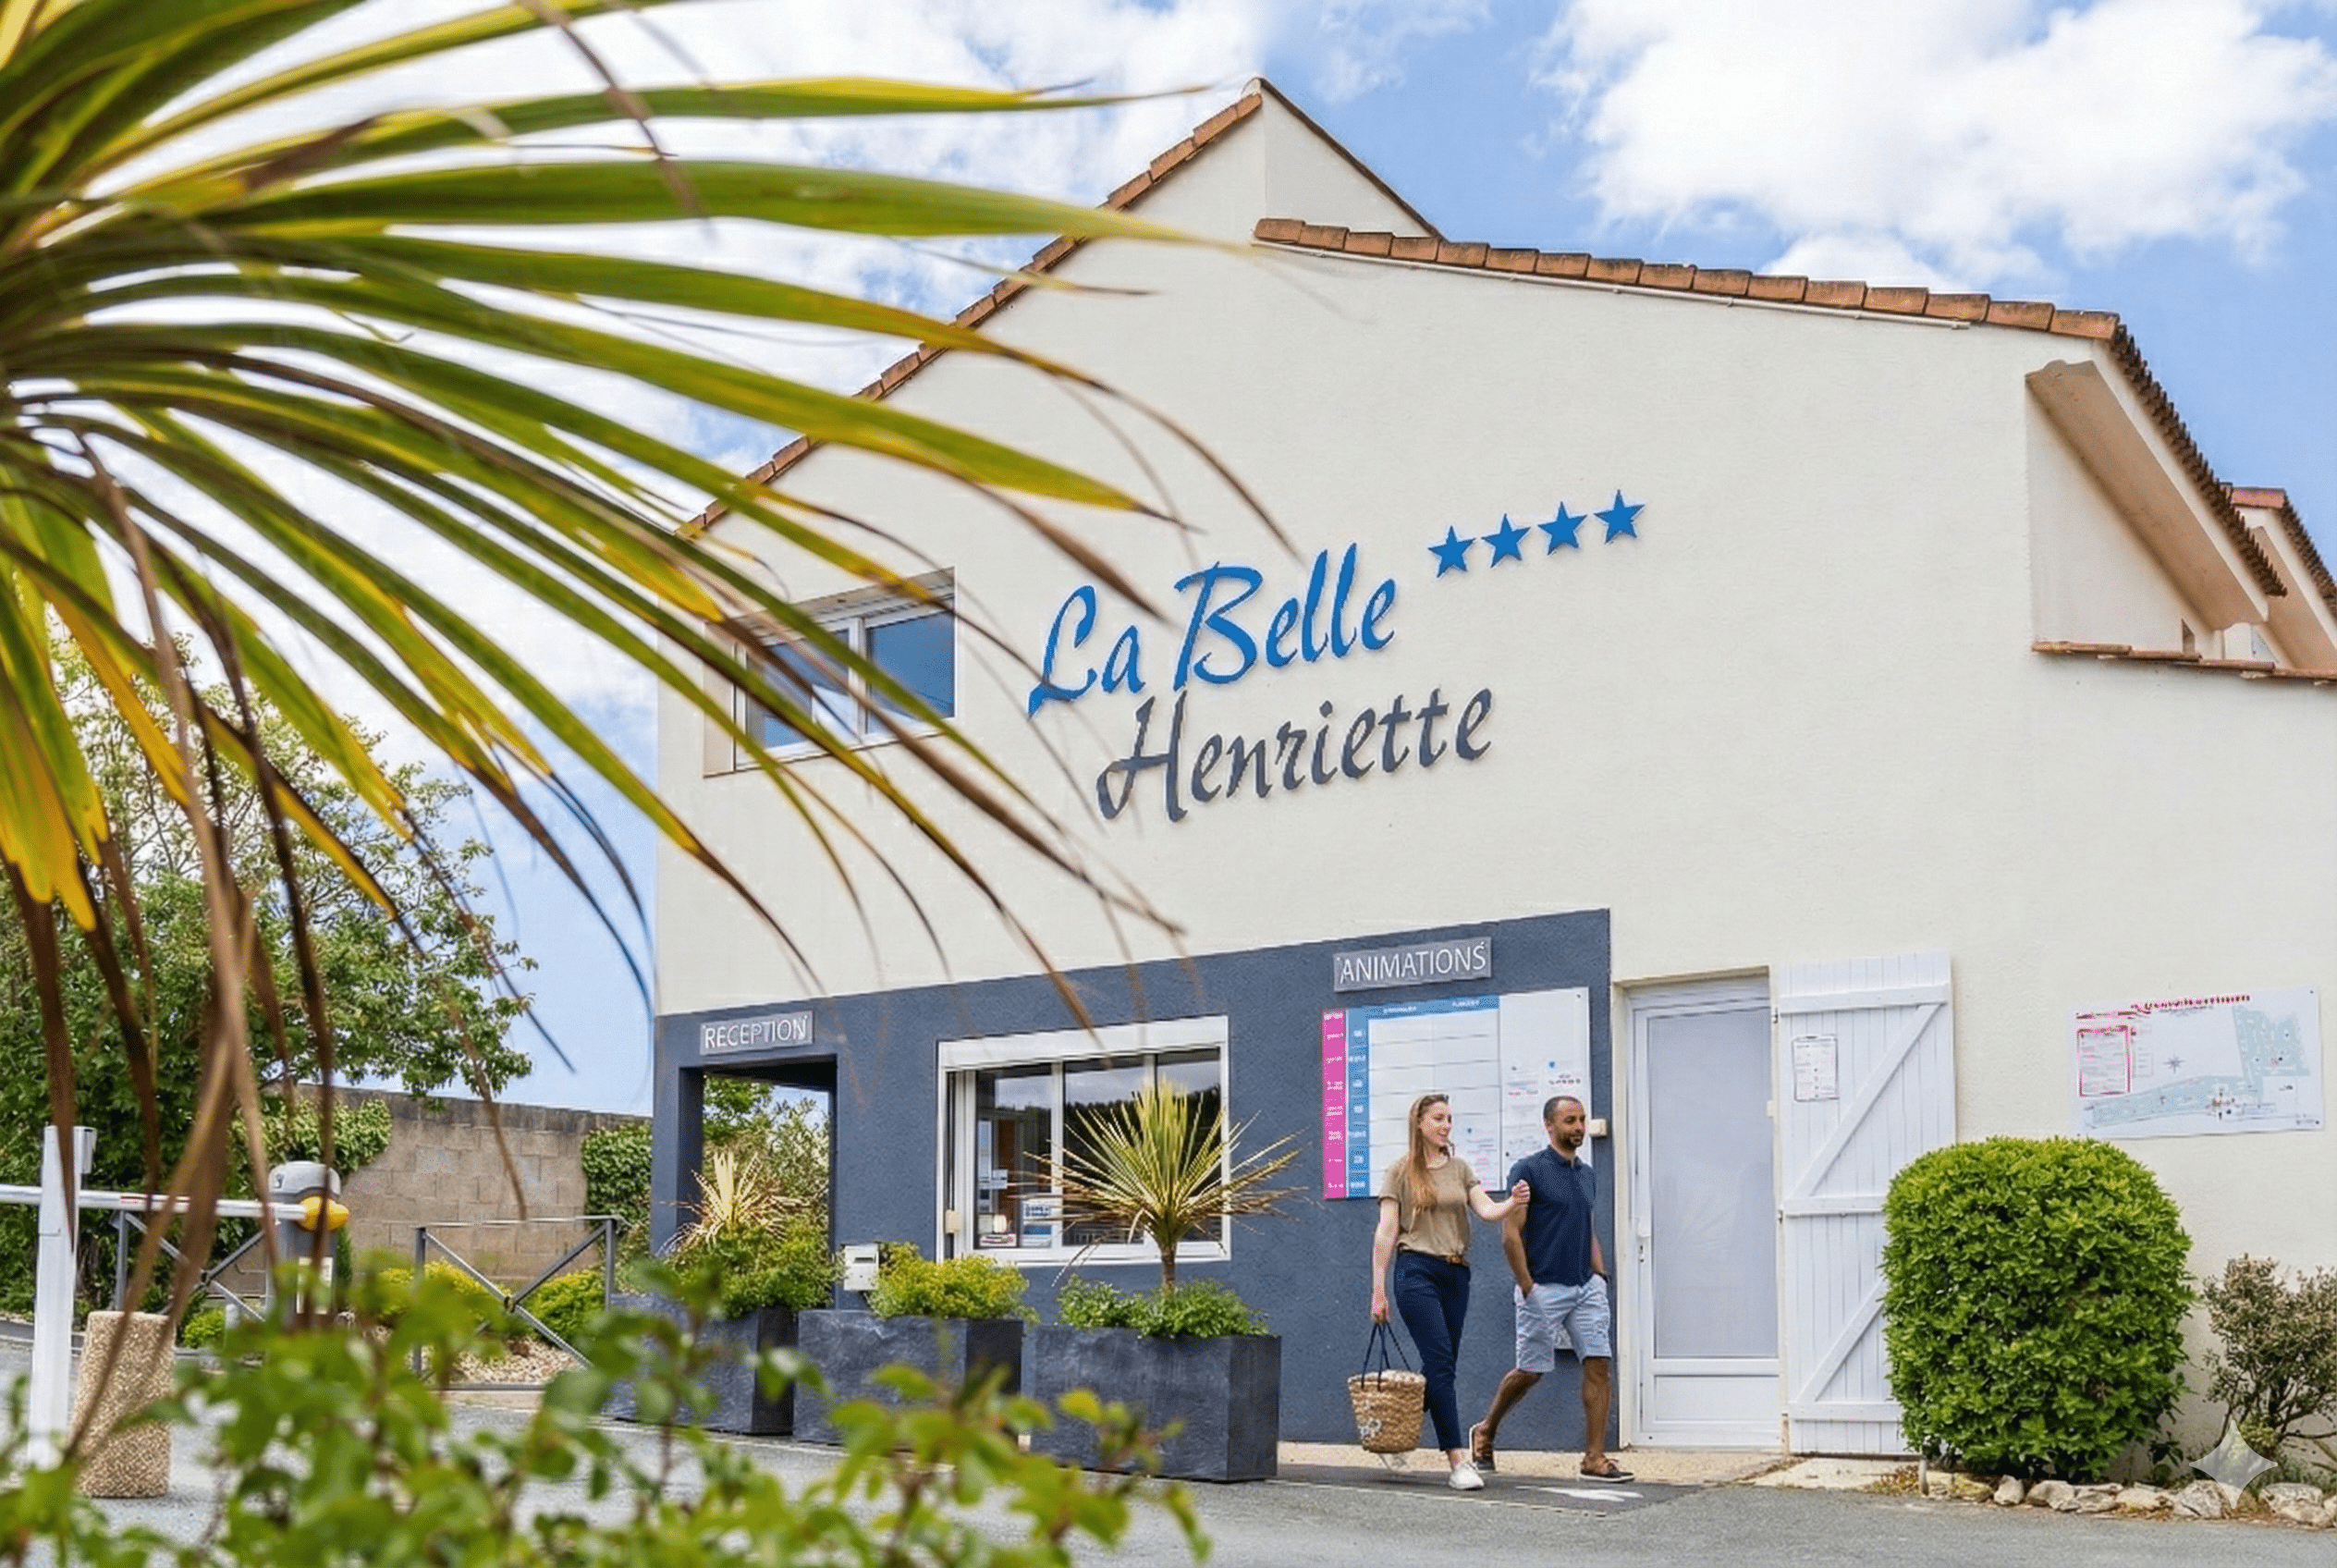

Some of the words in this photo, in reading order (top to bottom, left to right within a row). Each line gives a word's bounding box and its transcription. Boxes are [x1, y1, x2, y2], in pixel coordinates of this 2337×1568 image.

[1028, 584, 1146, 720] La
[1173, 542, 1397, 692] Belle
[1095, 687, 1492, 822] Henriette
[1340, 944, 1487, 984] ANIMATIONS
[704, 1019, 807, 1049] RECEPTION
